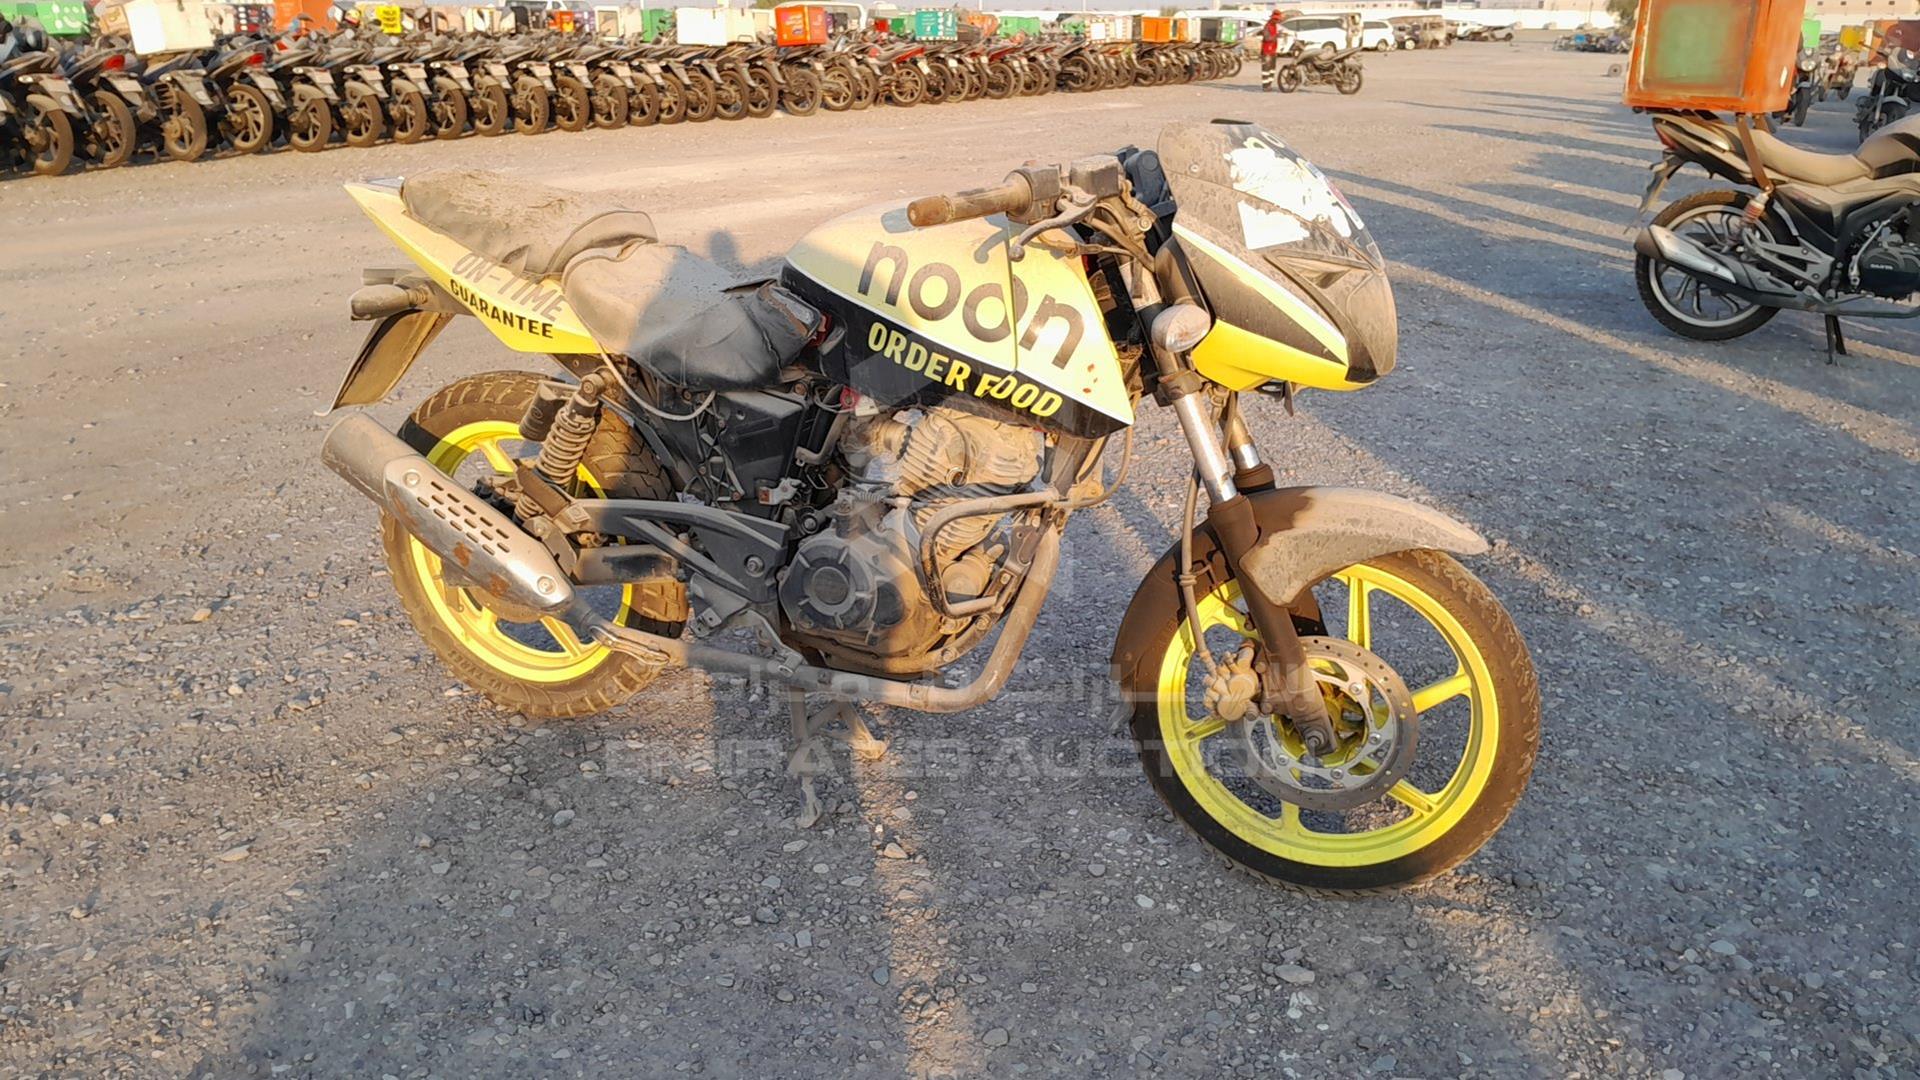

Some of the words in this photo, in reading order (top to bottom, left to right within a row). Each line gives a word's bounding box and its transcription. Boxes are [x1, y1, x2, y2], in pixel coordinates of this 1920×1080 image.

[450, 278, 554, 339] GUARANTEE
[452, 252, 566, 322] ON-TIME
[857, 240, 1085, 370] noon
[868, 321, 971, 393] ORDER
[974, 370, 1063, 418] FOOD
